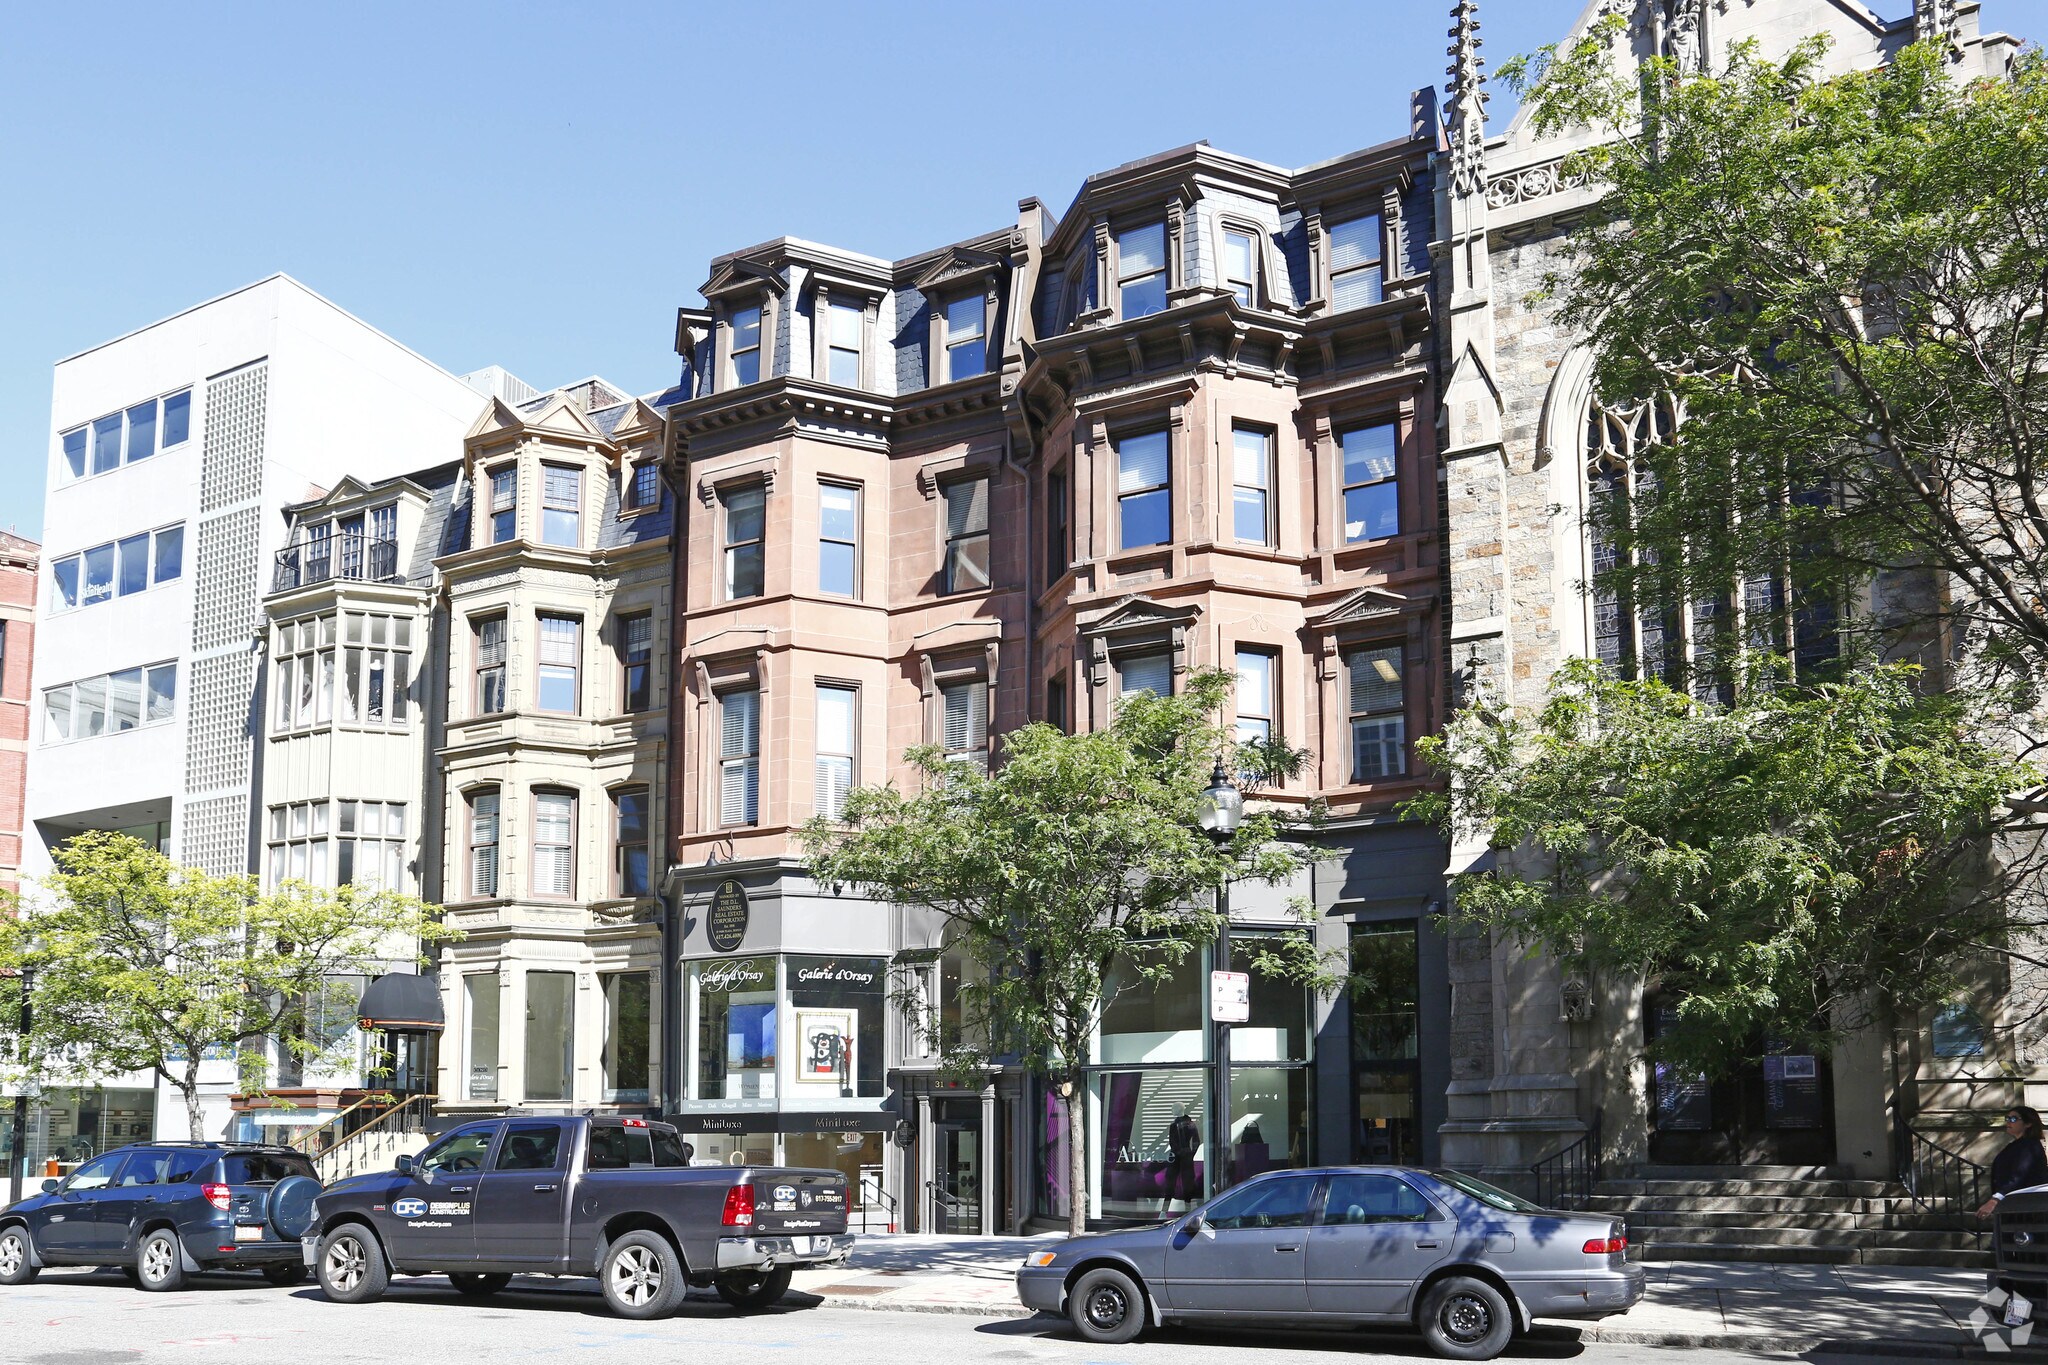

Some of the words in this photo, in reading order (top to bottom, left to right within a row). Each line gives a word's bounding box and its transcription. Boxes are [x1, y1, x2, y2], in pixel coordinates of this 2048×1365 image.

[728, 910, 745, 918] ESTATE
[713, 916, 746, 925] CORPORATION
[700, 971, 730, 986] Galerie
[731, 970, 764, 984] d'Orsay
[798, 967, 833, 983] Galerie
[835, 969, 874, 985] d'Orsay
[935, 1080, 944, 1088] 31
[702, 1118, 742, 1129] MiniLuxe
[815, 1117, 861, 1128] MiniLuxe
[846, 1133, 858, 1142] EXIT
